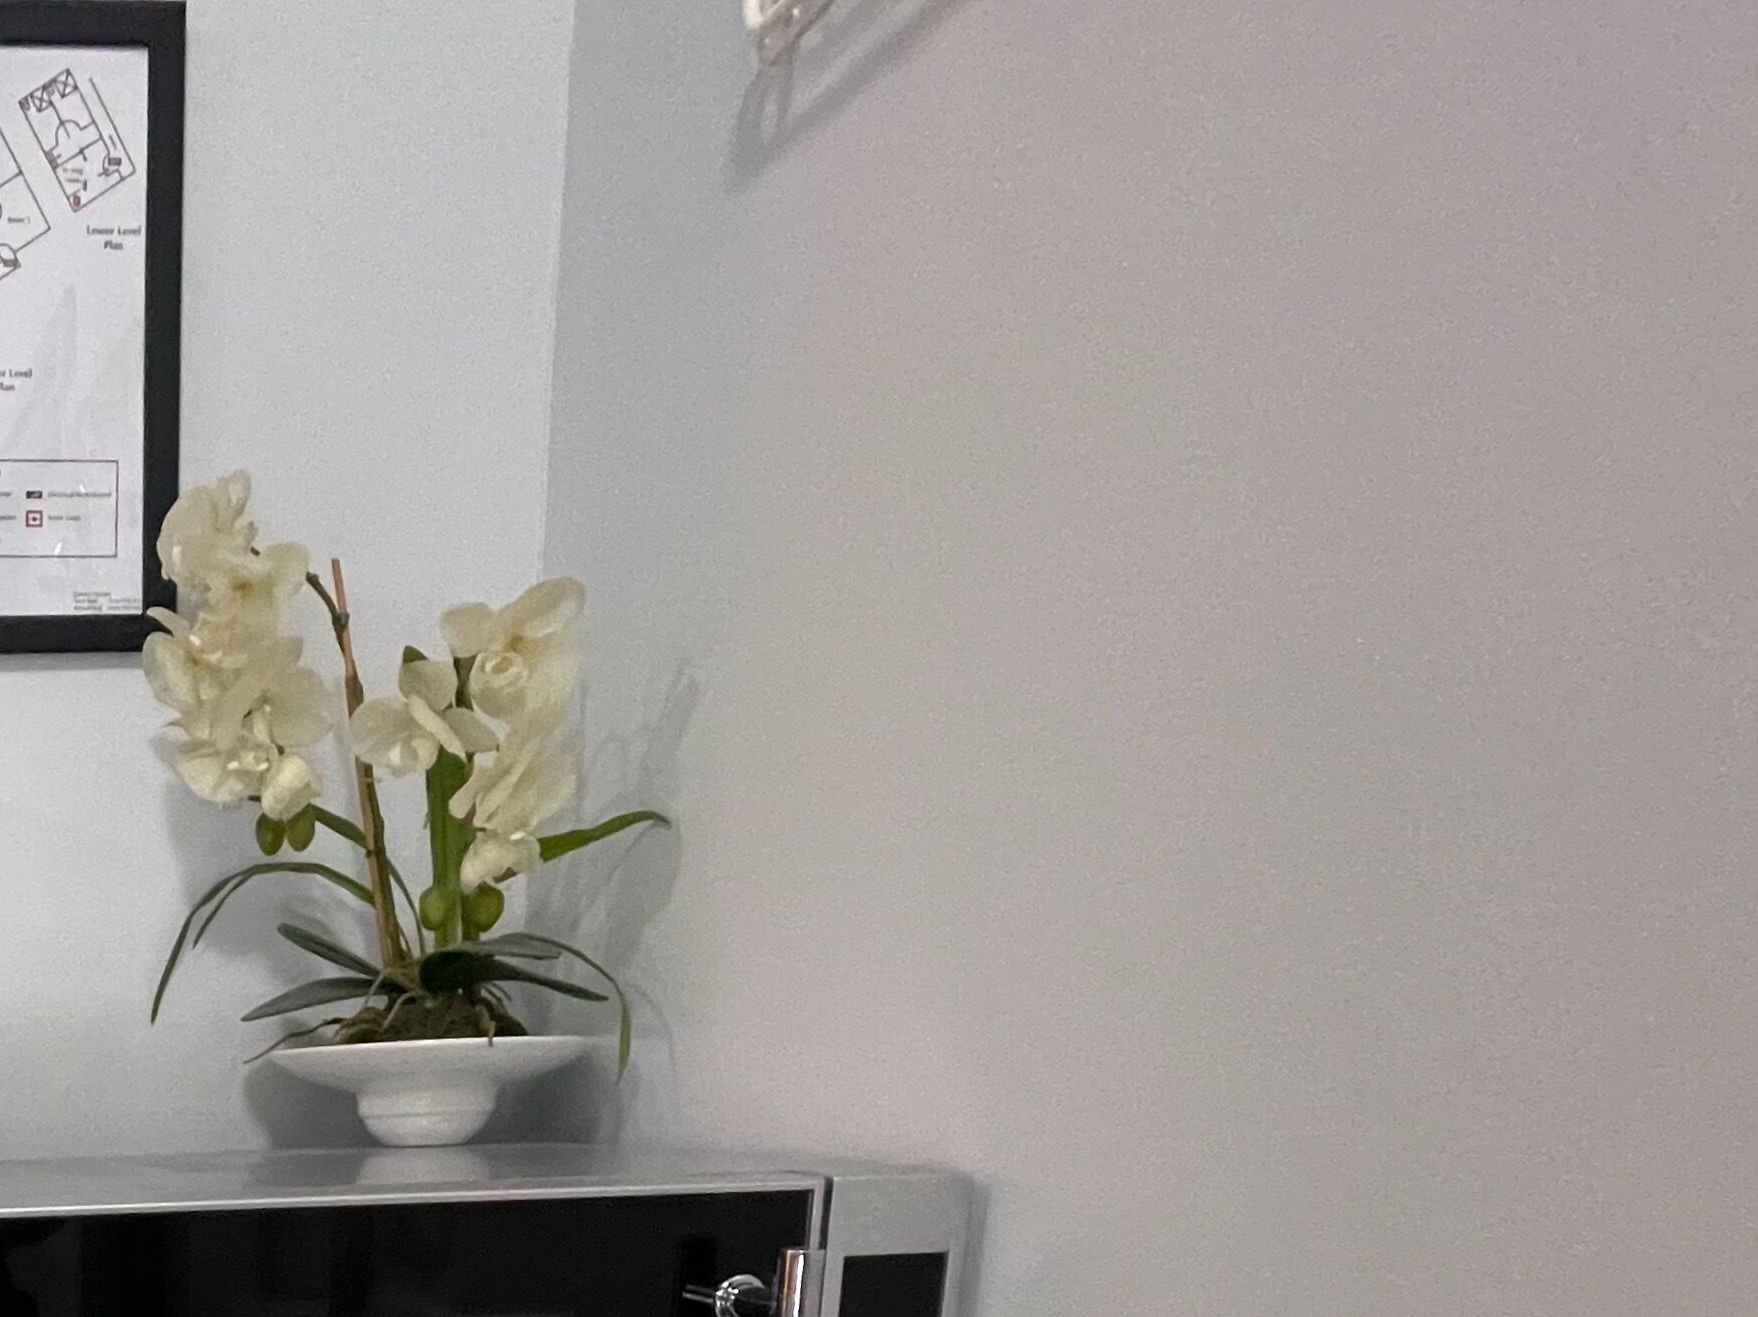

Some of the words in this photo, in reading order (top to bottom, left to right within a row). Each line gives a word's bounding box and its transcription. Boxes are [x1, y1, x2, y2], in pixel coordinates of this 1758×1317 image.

[86, 224, 115, 236] Lower
[117, 224, 142, 236] Level
[104, 239, 124, 251] Plan
[8, 367, 33, 379] Level
